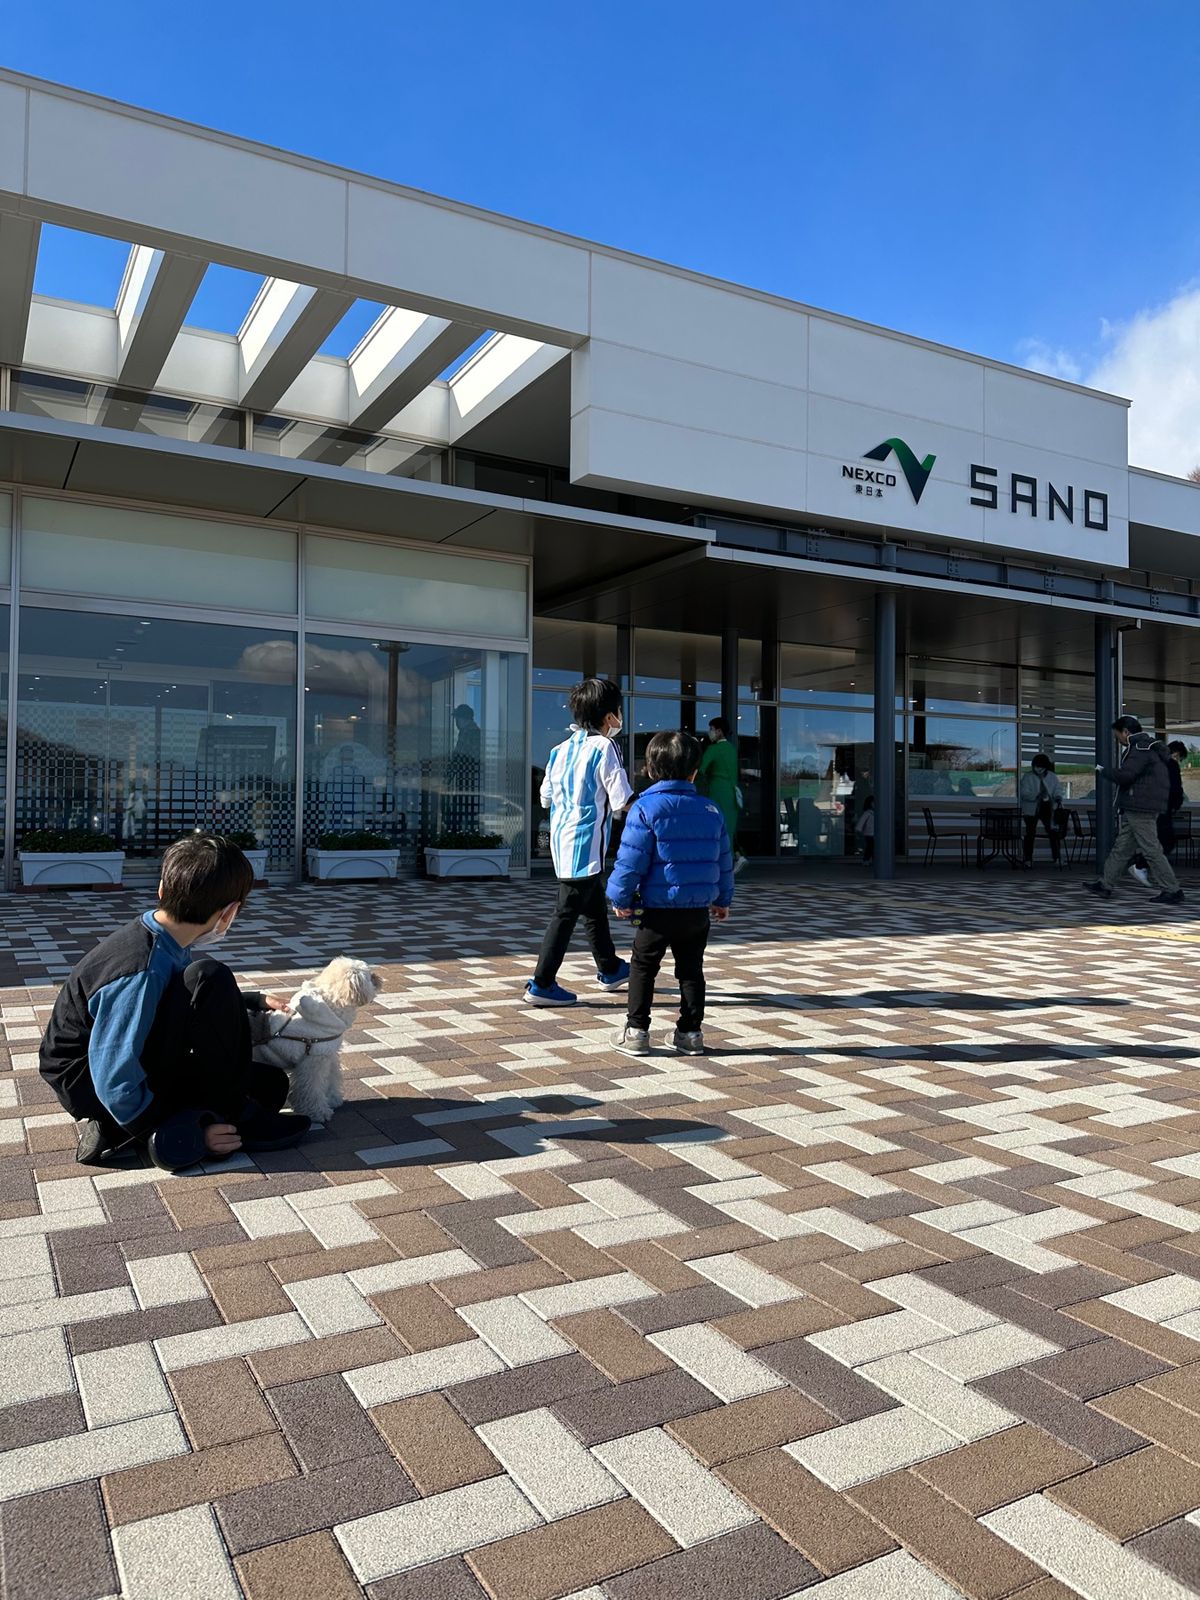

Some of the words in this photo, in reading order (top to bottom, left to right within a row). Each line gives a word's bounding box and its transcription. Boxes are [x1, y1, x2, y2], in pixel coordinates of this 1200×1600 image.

[842, 465, 897, 487] NEXCO
[855, 484, 883, 498] 東日本
[970, 463, 1109, 532] SANO
